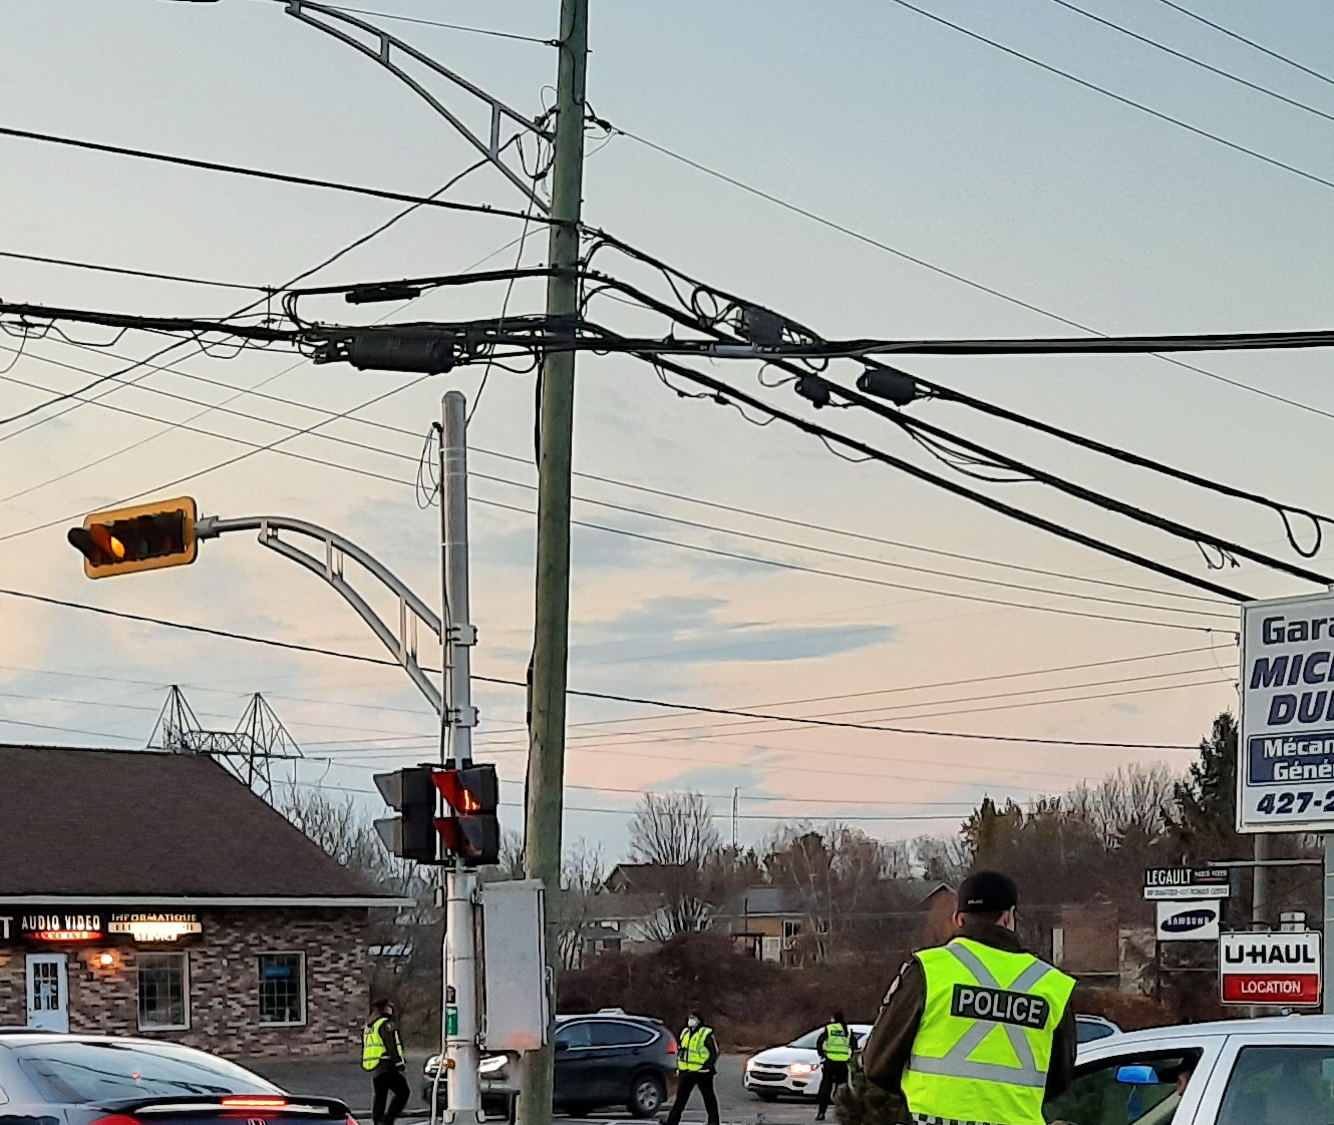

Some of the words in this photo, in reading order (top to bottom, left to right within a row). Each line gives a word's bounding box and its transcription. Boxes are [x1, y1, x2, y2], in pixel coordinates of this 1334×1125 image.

[1146, 869, 1192, 885] LEGAULT
[22, 915, 59, 931] AUDIO
[65, 915, 101, 931] VIDEO
[1225, 944, 1315, 964] U-HAUL
[1241, 980, 1301, 994] LOCATION
[958, 988, 1044, 1024] POLICE
